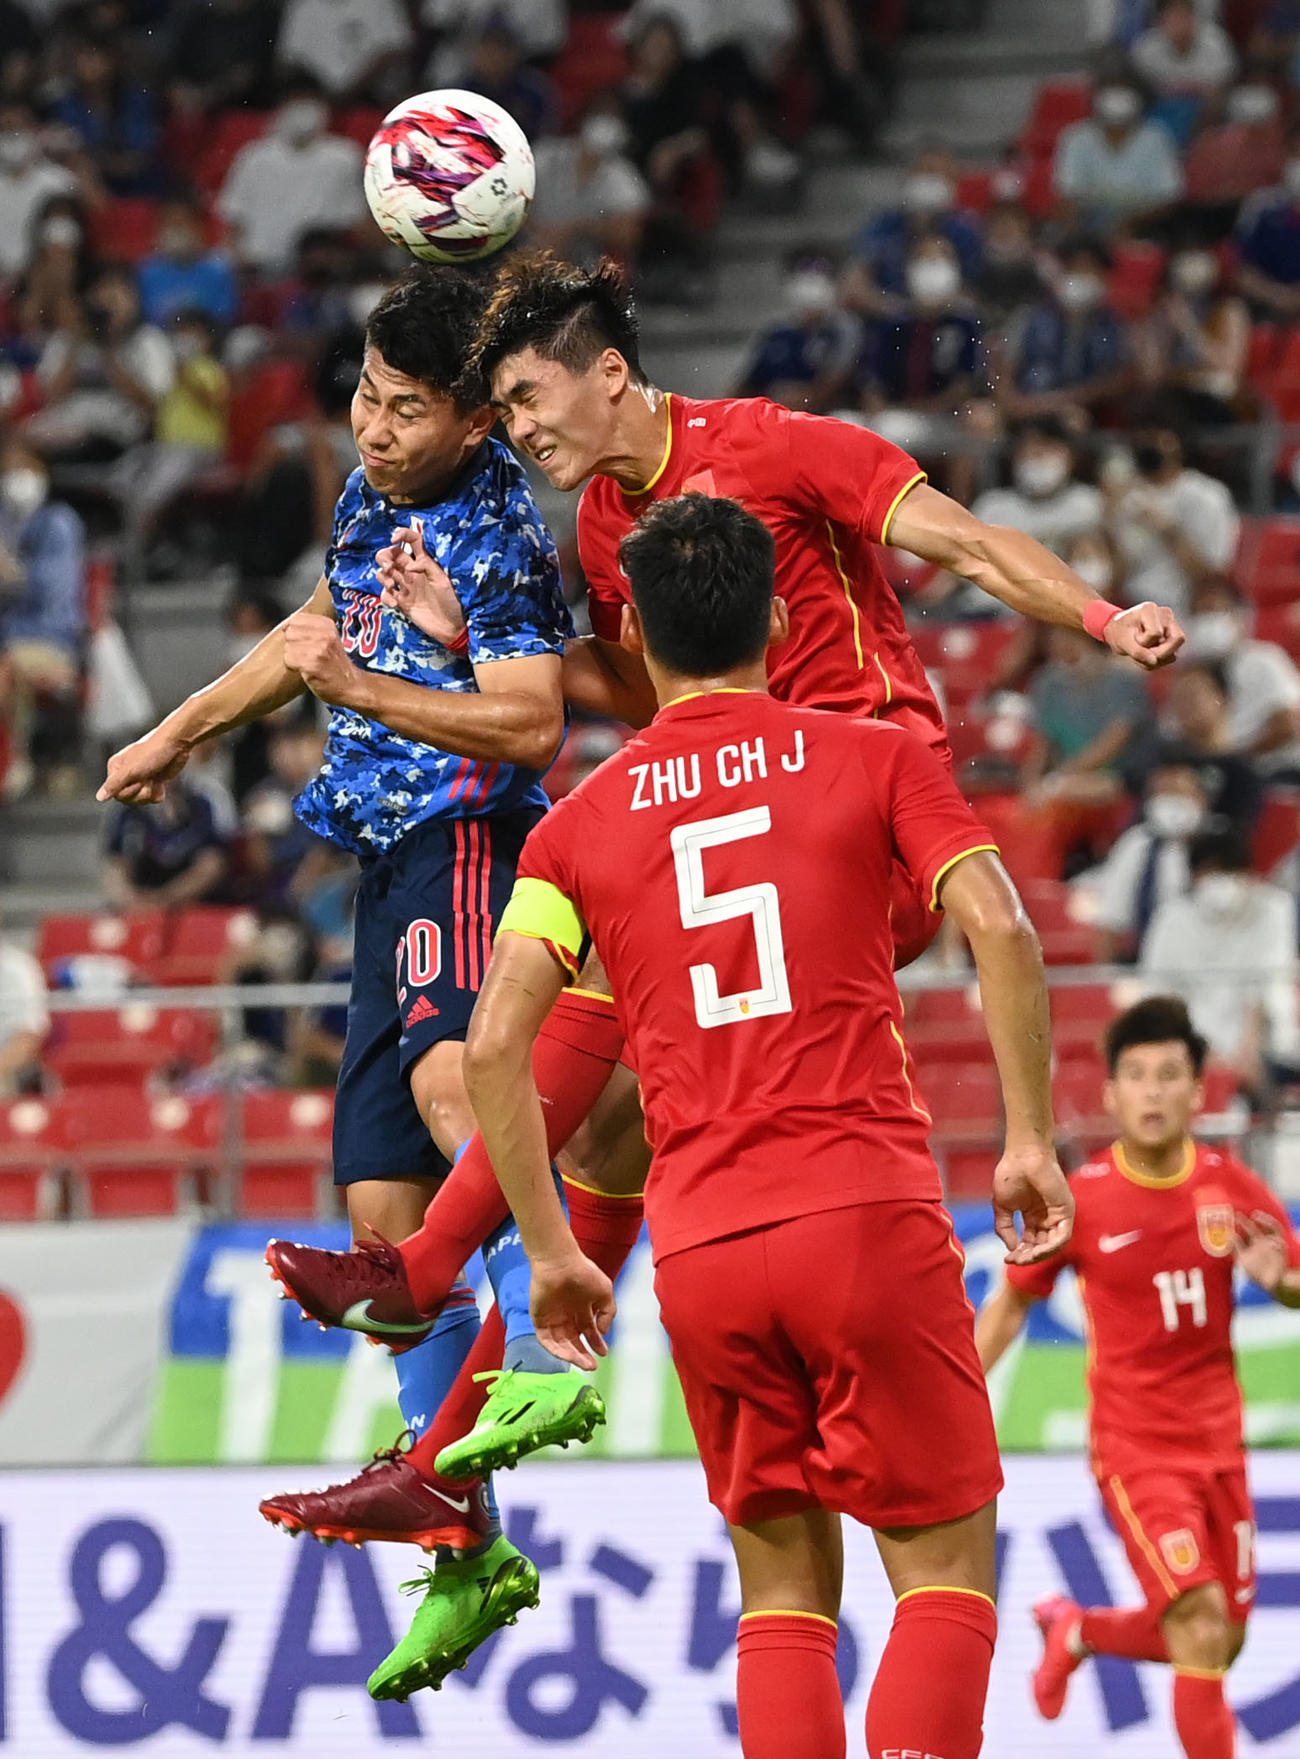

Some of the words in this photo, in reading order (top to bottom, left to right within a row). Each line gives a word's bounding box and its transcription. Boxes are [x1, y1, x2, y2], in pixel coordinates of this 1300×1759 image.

[341, 588, 382, 657] 20
[628, 753, 702, 811] ZHU
[716, 736, 768, 788] CH
[781, 729, 805, 773] J
[670, 805, 793, 1029] 5
[1153, 1267, 1207, 1332] 14
